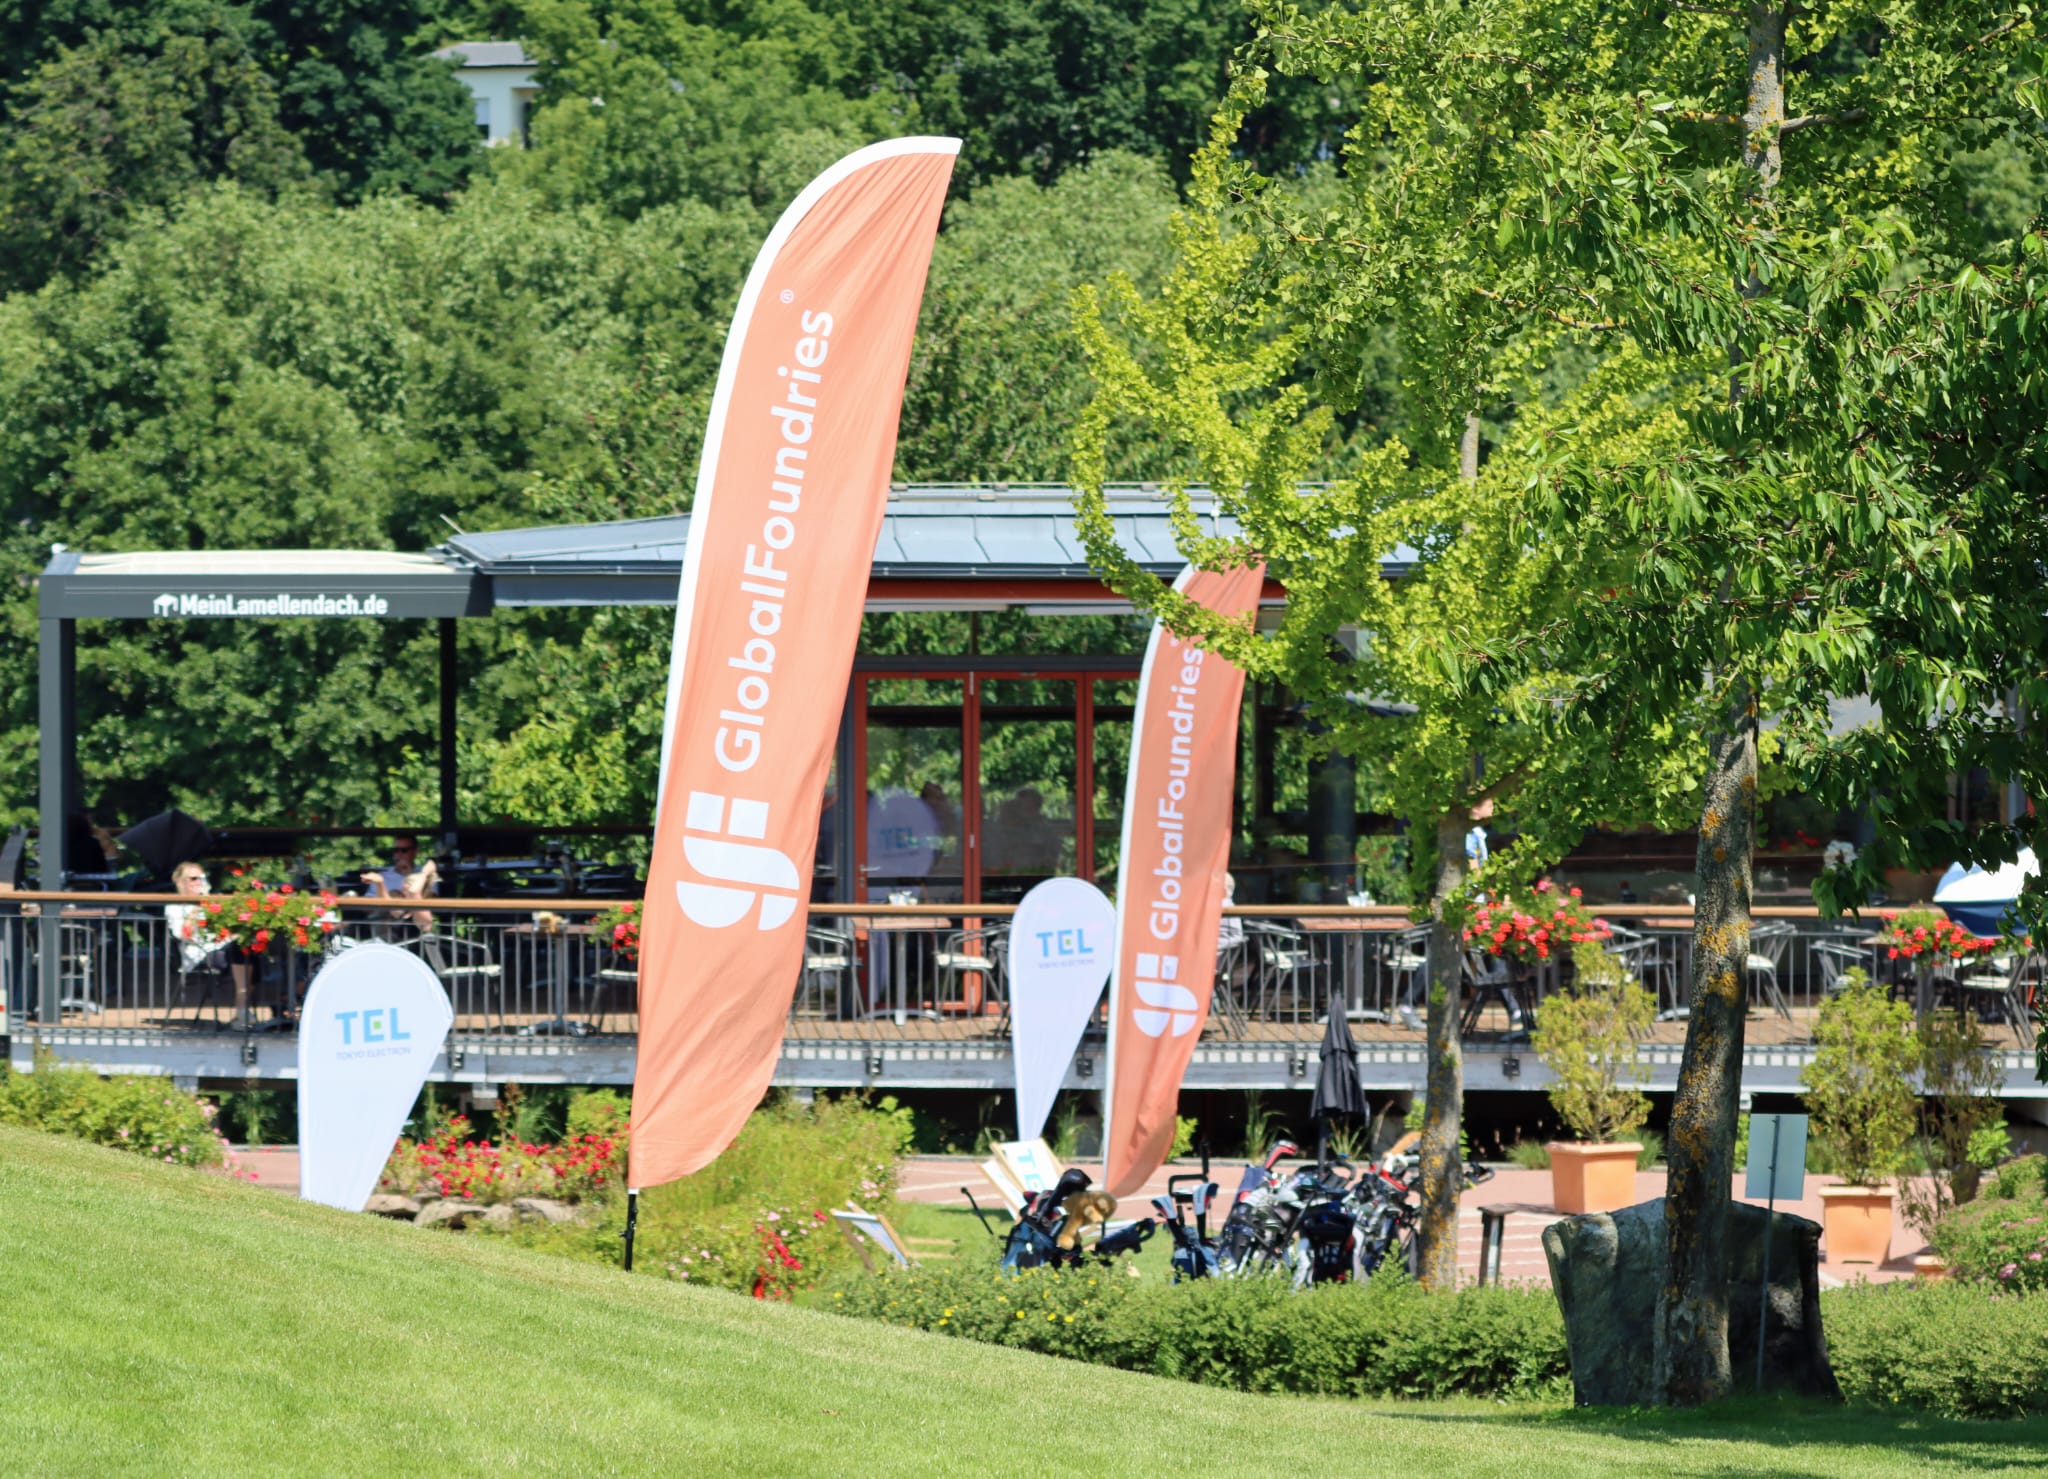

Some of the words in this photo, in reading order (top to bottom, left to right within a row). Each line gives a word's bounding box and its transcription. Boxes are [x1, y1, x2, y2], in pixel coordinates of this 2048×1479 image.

[180, 593, 389, 616] MeinLamellendach.de
[1148, 646, 1206, 942] GlobalFoundries
[1035, 927, 1095, 959] TEL
[334, 1007, 411, 1045] TEL
